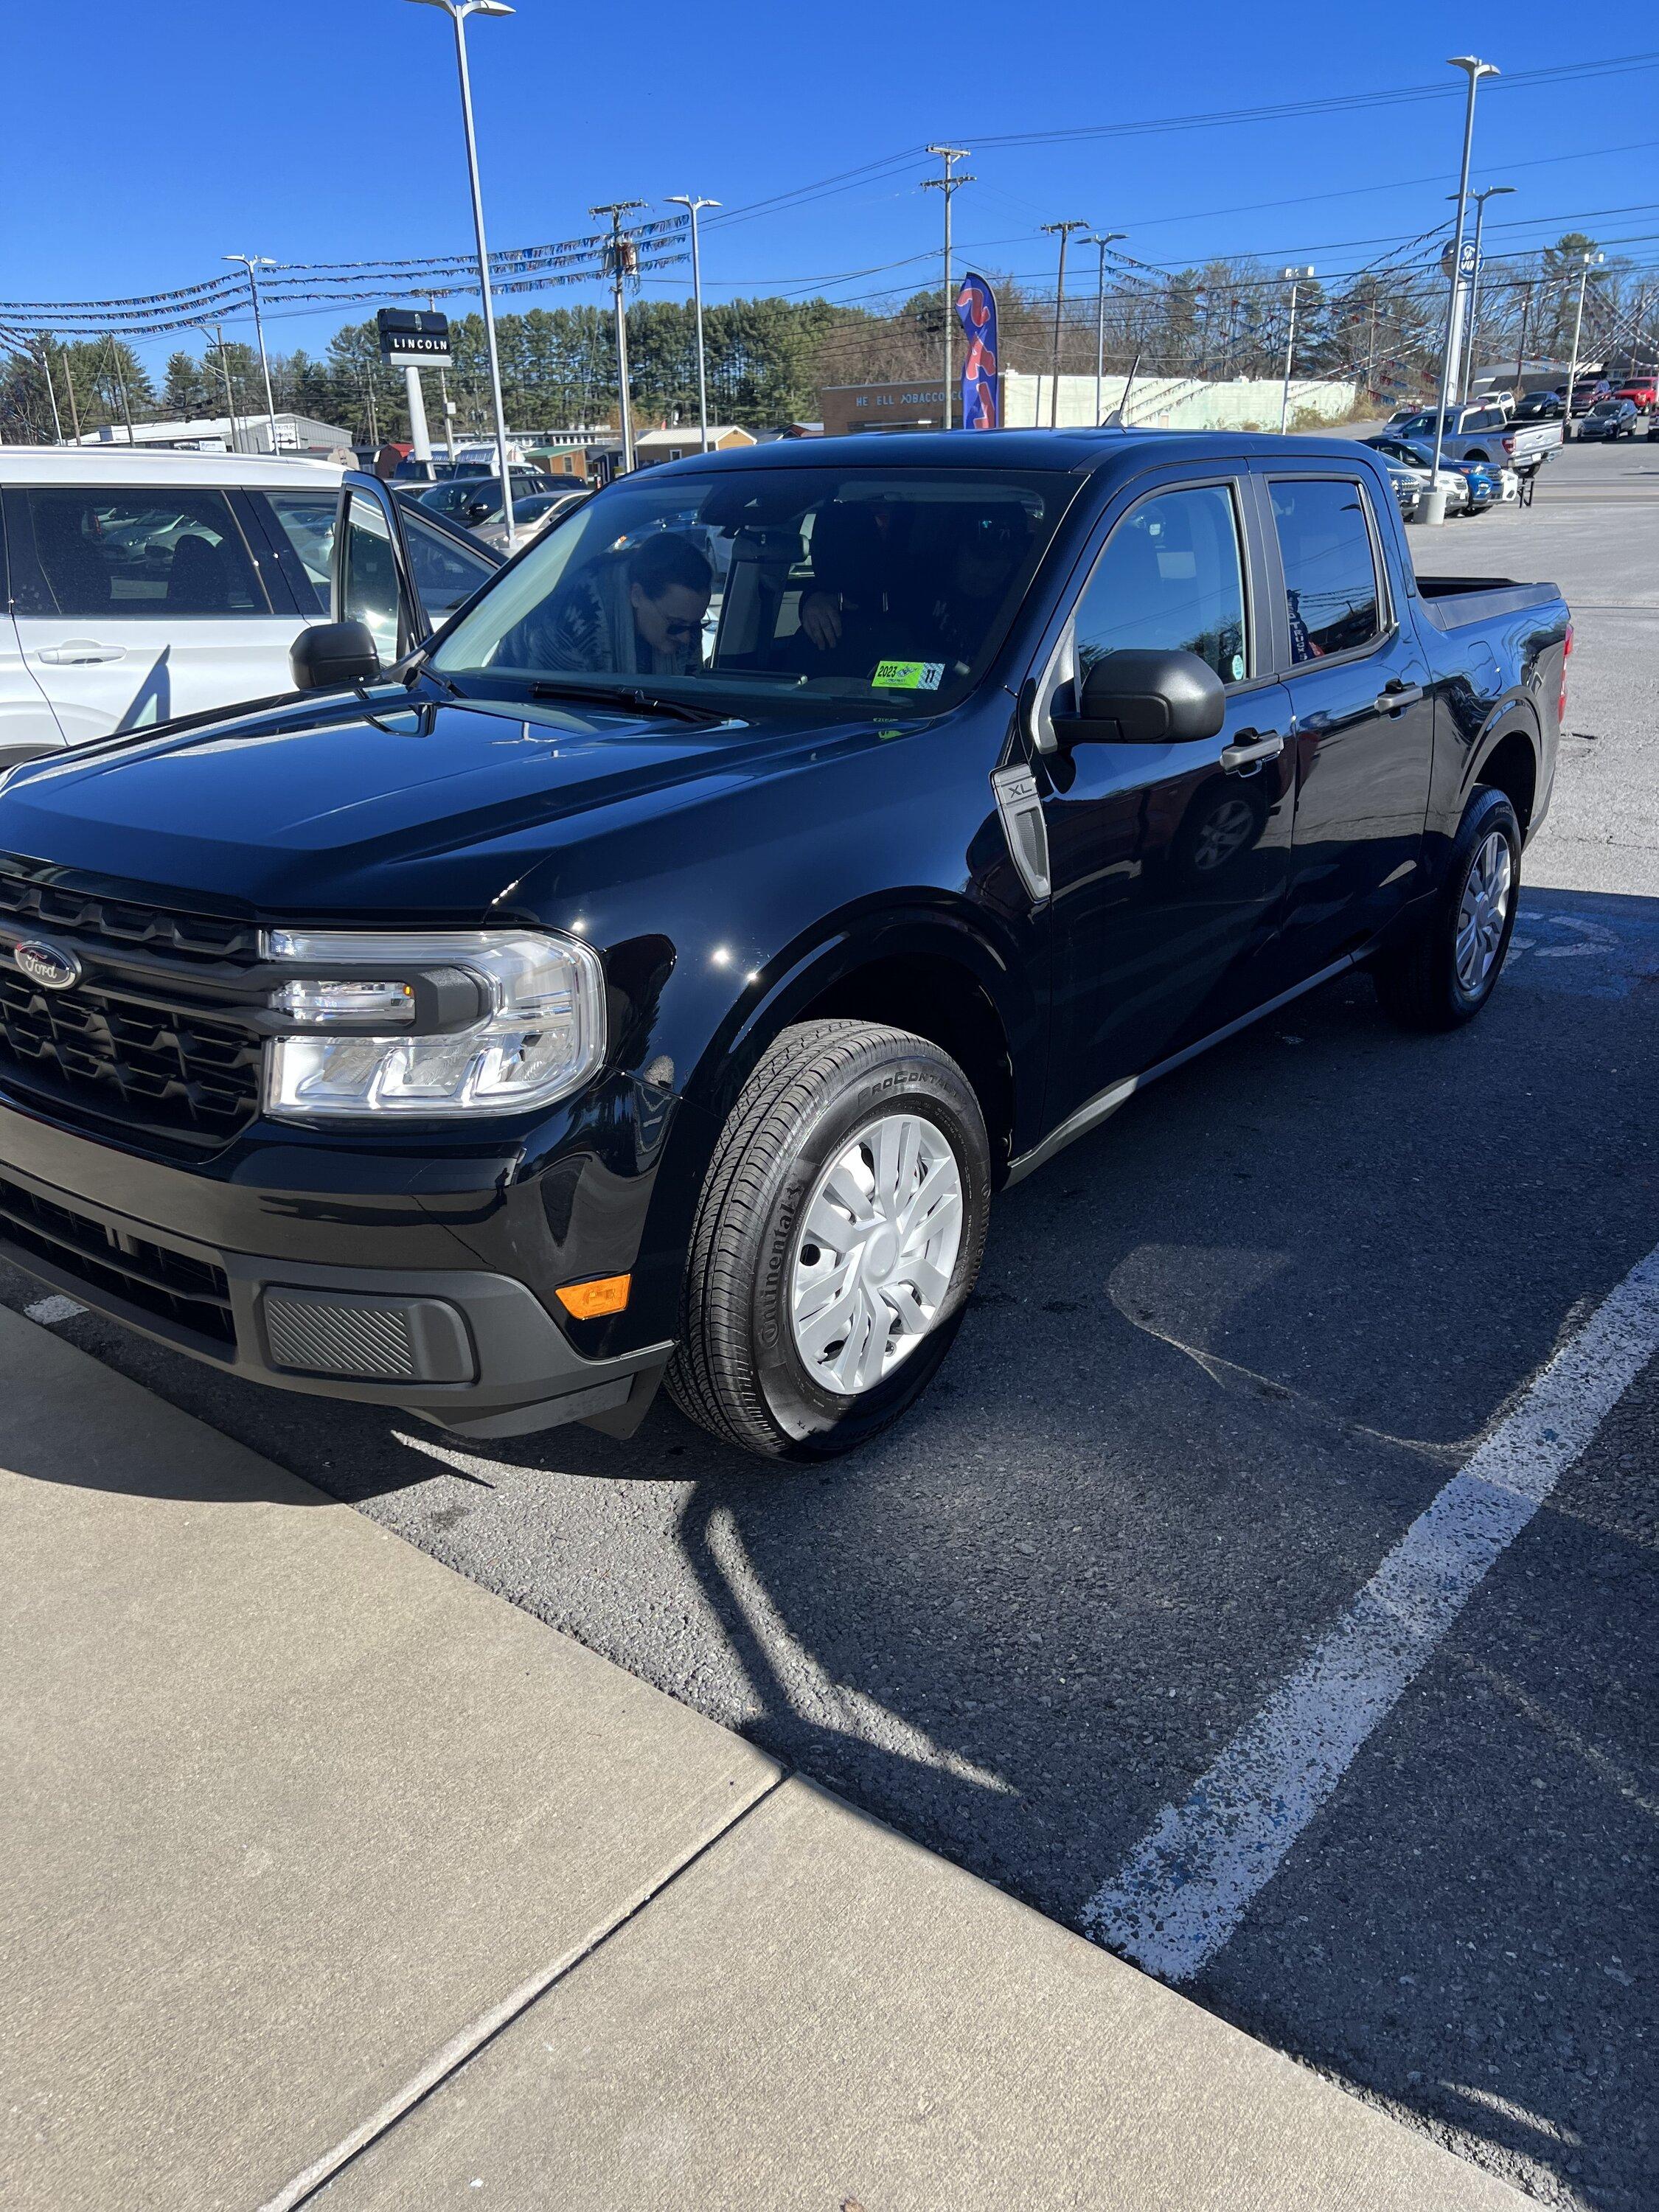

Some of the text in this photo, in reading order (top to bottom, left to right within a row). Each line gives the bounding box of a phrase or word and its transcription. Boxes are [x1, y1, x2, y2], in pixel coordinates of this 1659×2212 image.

[394, 338, 448, 350] LINCOLN
[877, 665, 936, 684] 2023 11
[1008, 783, 1032, 799] XL
[26, 950, 58, 979] Ford
[761, 1203, 796, 1349] Continental
